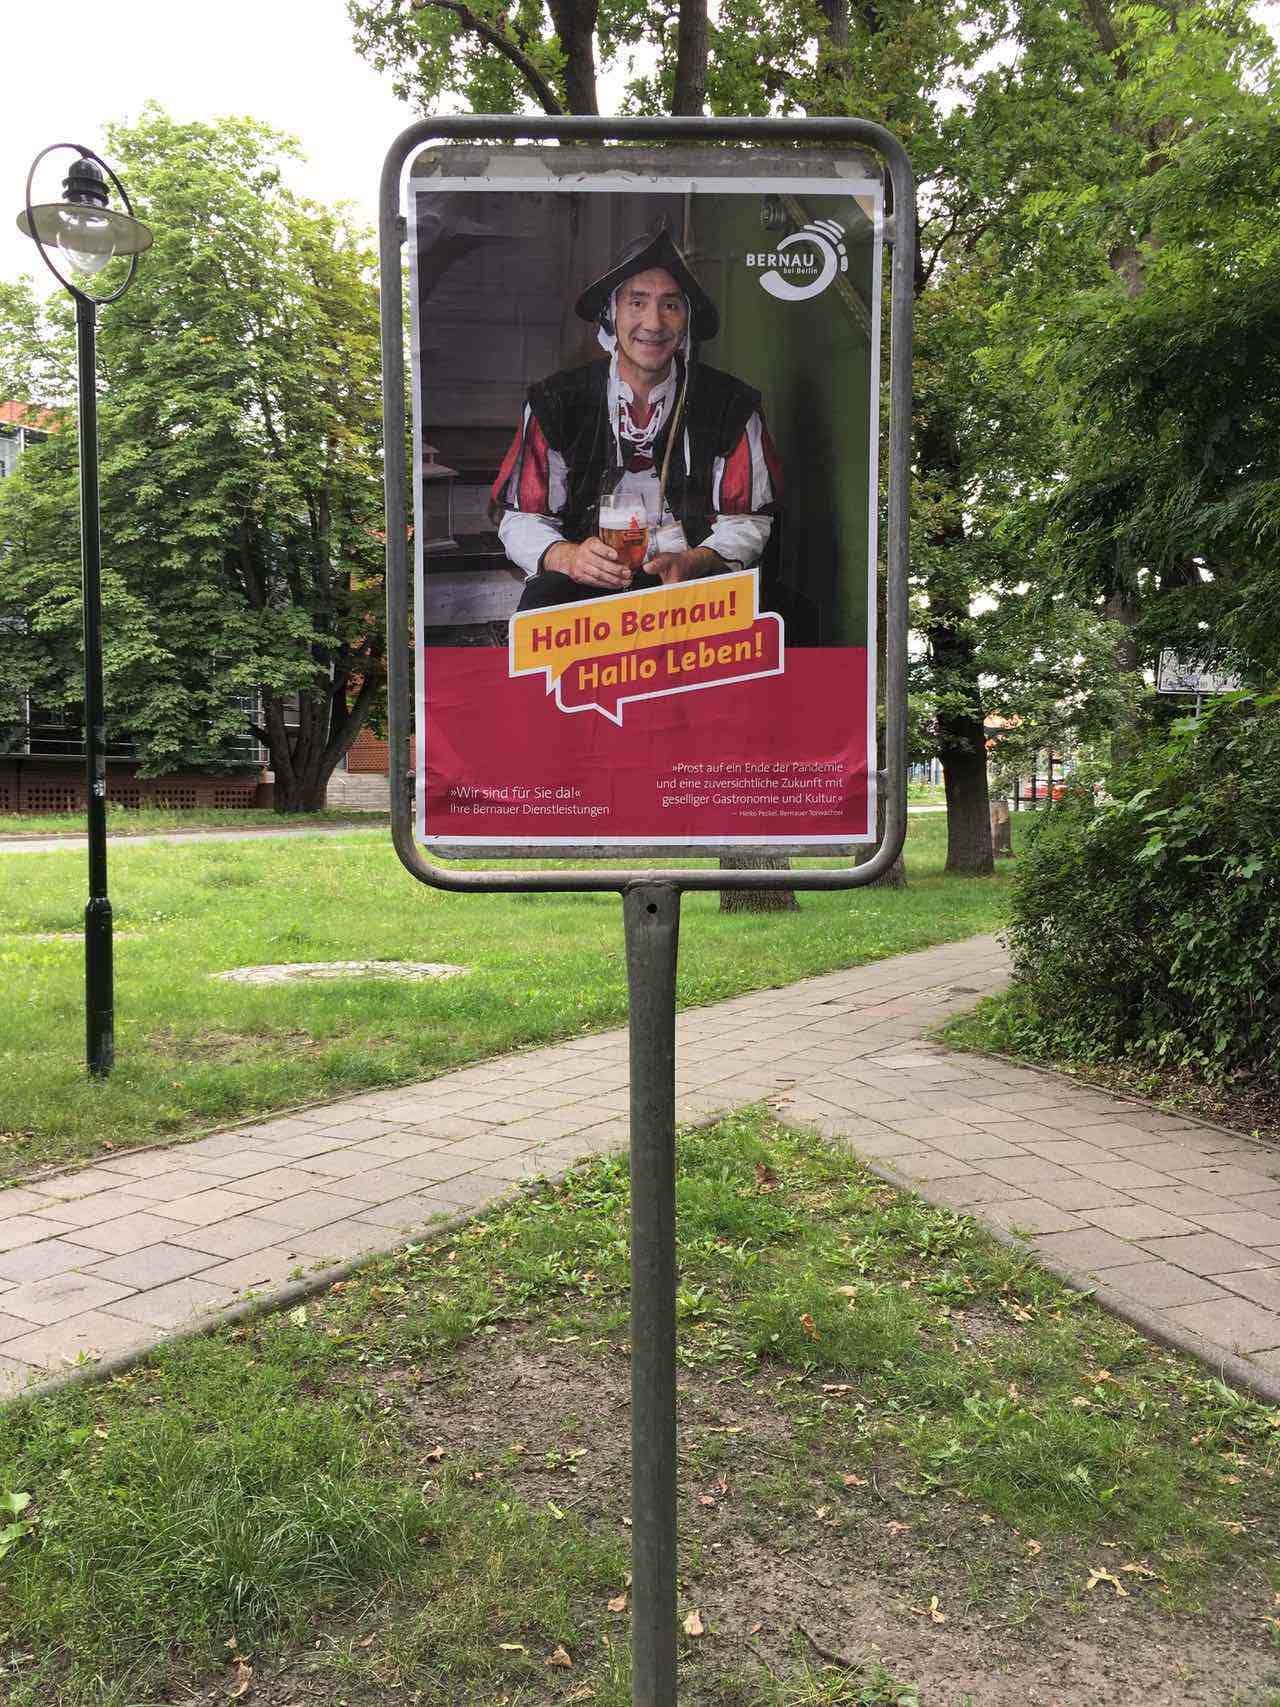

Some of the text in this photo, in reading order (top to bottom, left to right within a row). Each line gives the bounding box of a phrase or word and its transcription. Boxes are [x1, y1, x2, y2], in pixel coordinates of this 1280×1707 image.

[746, 253, 815, 267] BERNAU
[797, 266, 818, 274] Berlin
[532, 590, 736, 652] Hallo Bernau!
[578, 632, 763, 690] Hallo Leben!
[706, 762, 723, 773] auf
[727, 762, 741, 773] ein
[745, 762, 769, 773] Ende
[773, 762, 789, 773] der
[792, 762, 843, 773] Pandemie
[656, 777, 842, 789] und eine zuversichtliche Zukunft mit
[482, 786, 508, 799] sind
[512, 786, 530, 799] für
[534, 786, 551, 799] Sie
[662, 794, 708, 808] geselliger
[712, 794, 778, 805] Gastronomie
[782, 793, 801, 804] und
[450, 803, 609, 817] Ihre Bernauer Dienstleistungen
